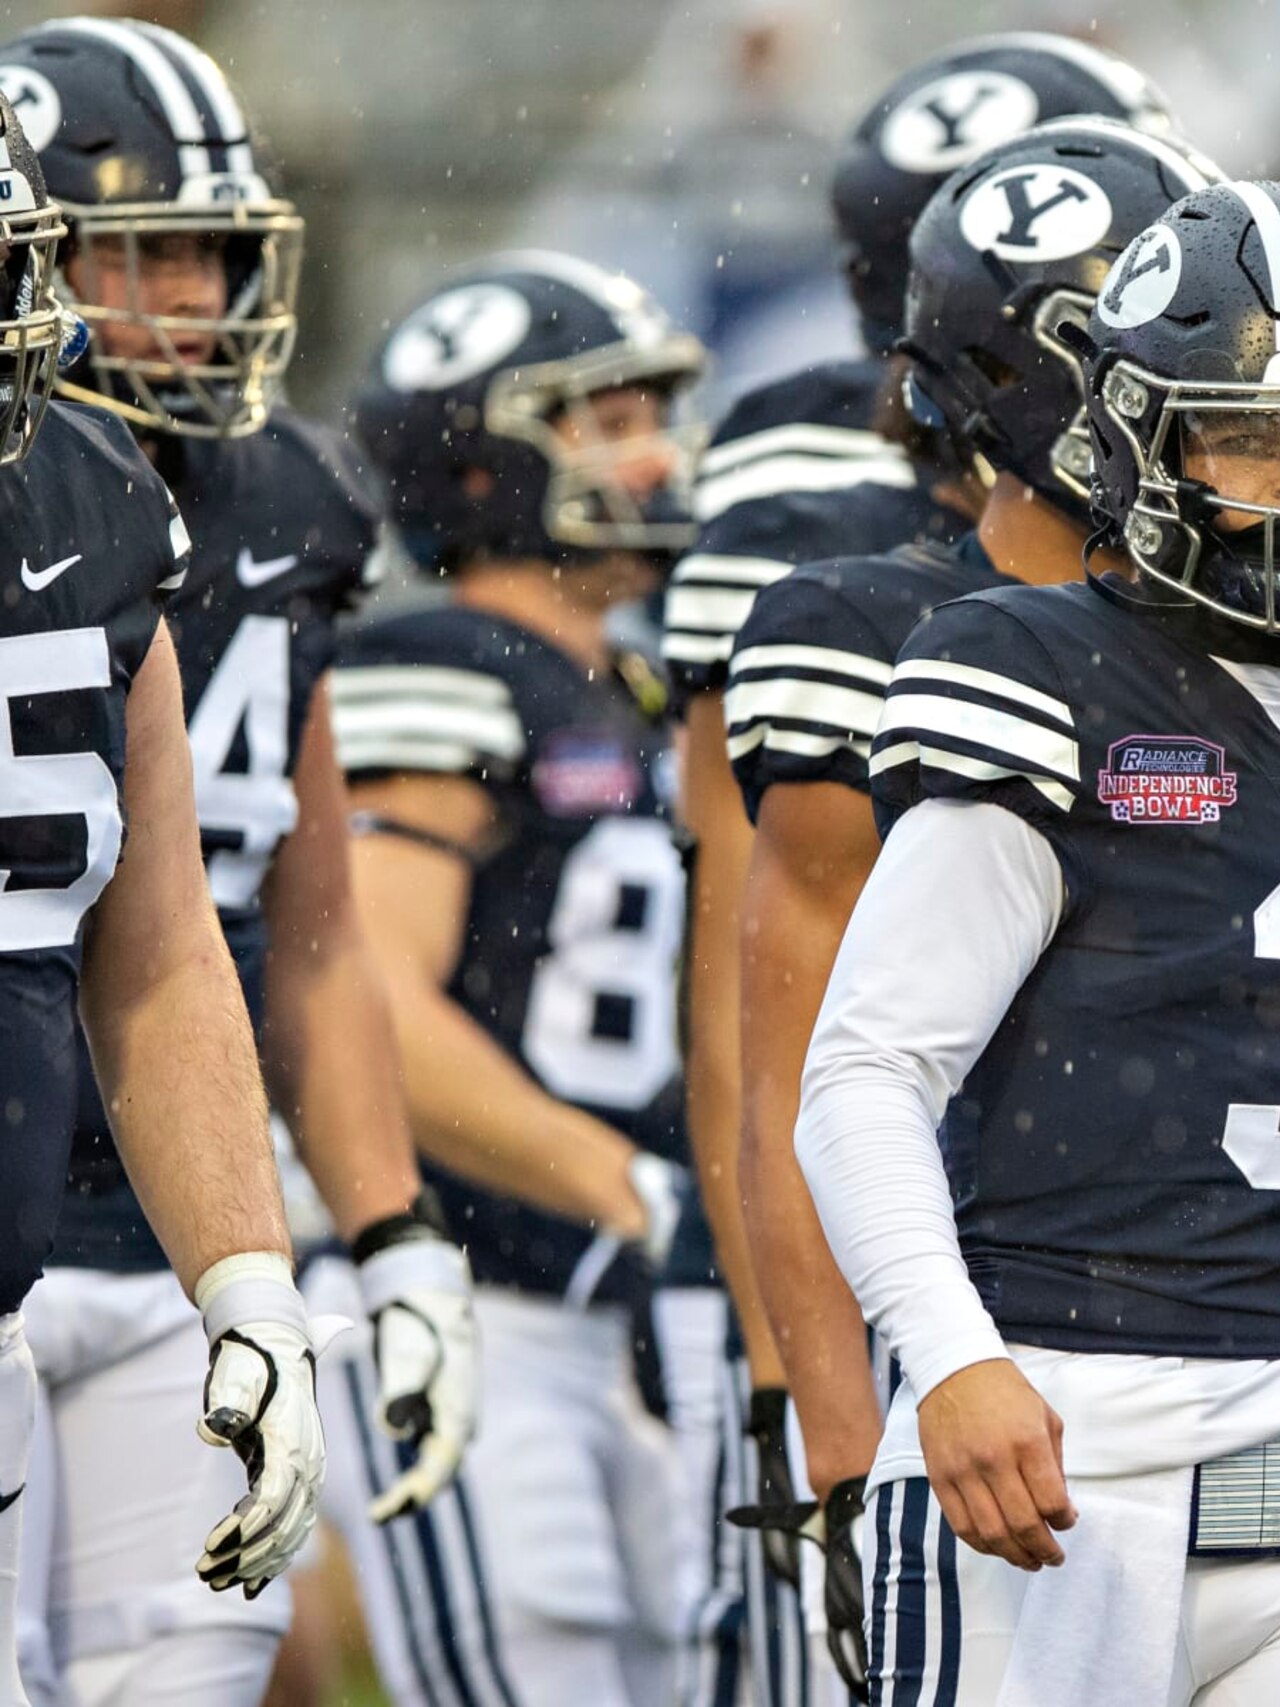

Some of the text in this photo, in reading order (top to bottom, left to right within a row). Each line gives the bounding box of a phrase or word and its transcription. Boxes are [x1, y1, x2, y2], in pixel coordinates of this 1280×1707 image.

[920, 85, 1002, 153] Y
[994, 173, 1089, 247] Y
[1103, 231, 1171, 315] Y
[188, 613, 299, 909] 4
[1103, 774, 1233, 798] INDEPENDENCE
[1120, 747, 1209, 771] RADIANCE
[1131, 796, 1199, 817] BOWL
[521, 816, 687, 1109] 8
